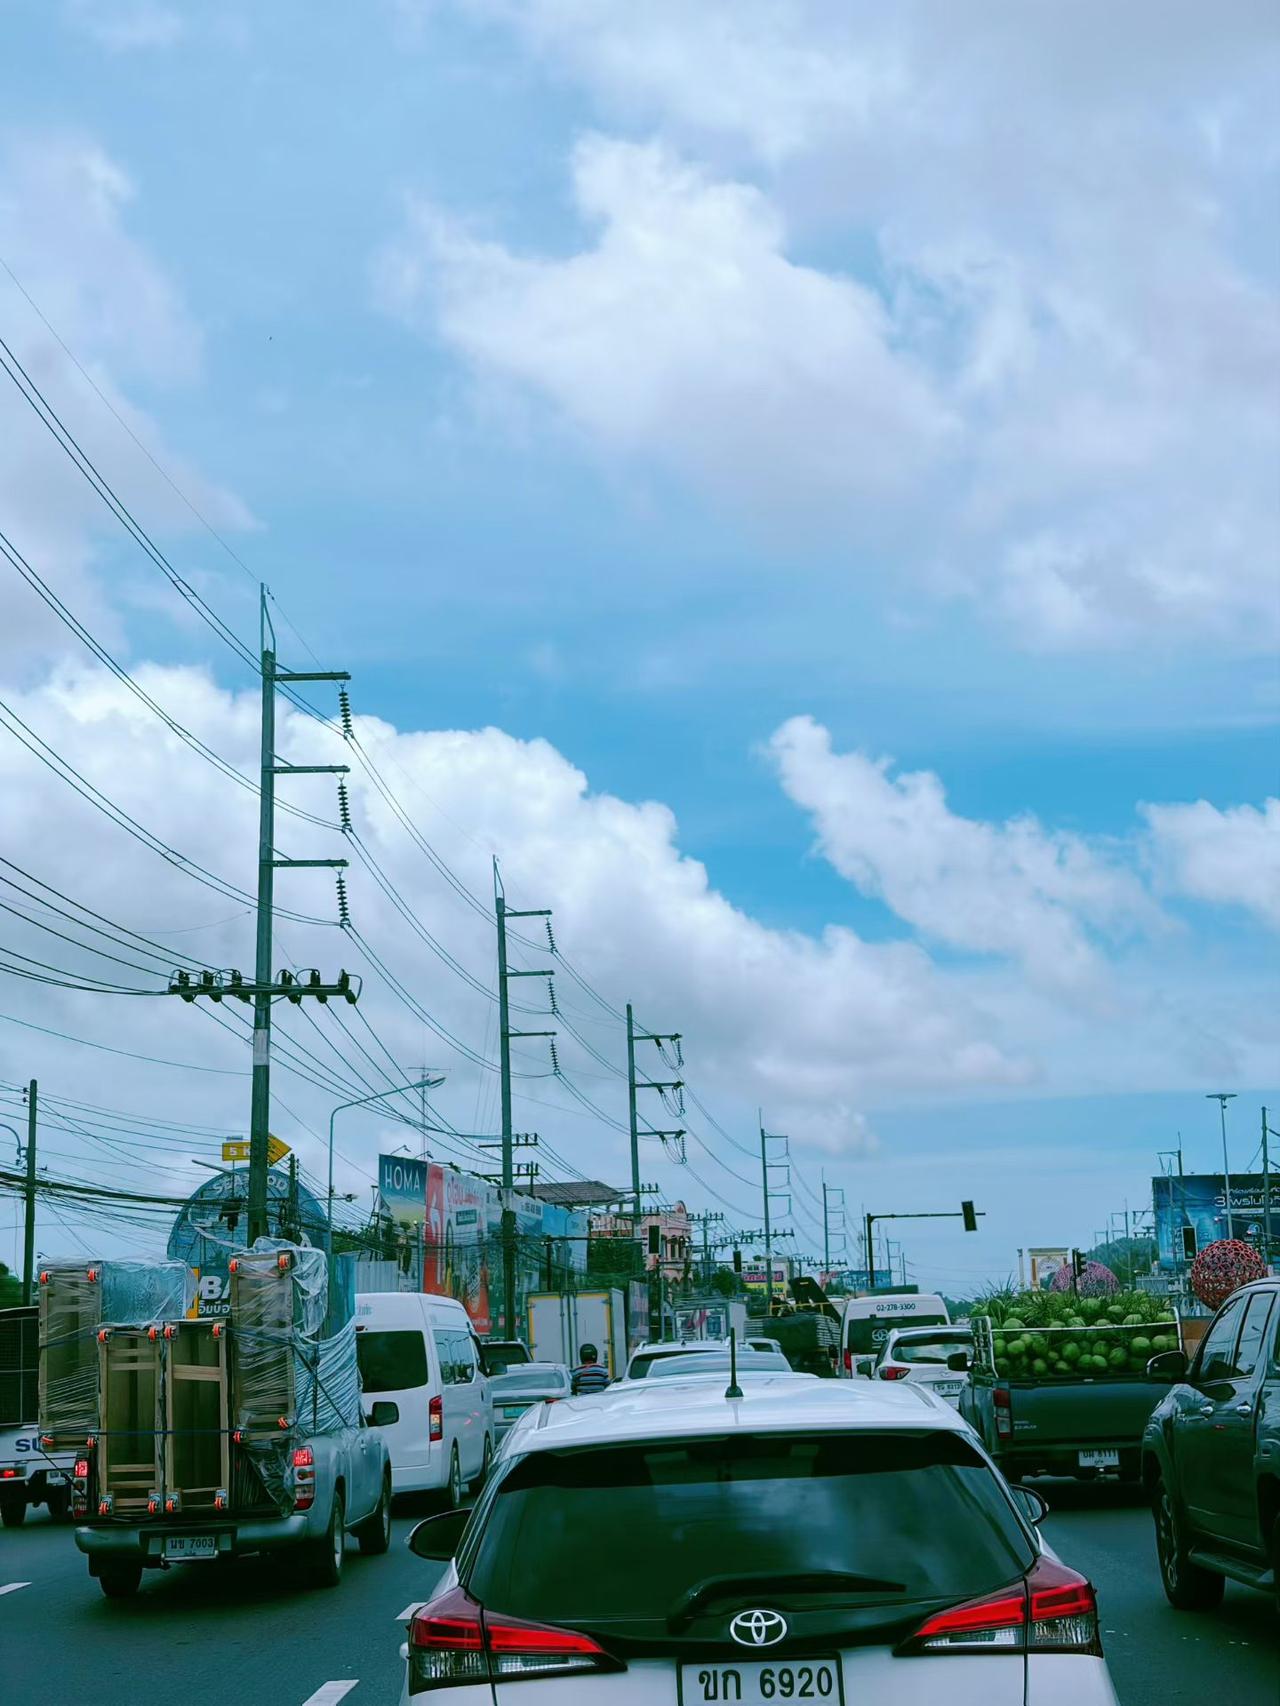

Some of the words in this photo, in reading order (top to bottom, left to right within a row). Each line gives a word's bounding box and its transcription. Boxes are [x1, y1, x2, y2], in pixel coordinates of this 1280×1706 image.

[385, 1164, 420, 1193] HOMA
[189, 1537, 214, 1549] 7003
[699, 1669, 742, 1701] ขก
[759, 1666, 833, 1699] 6920
